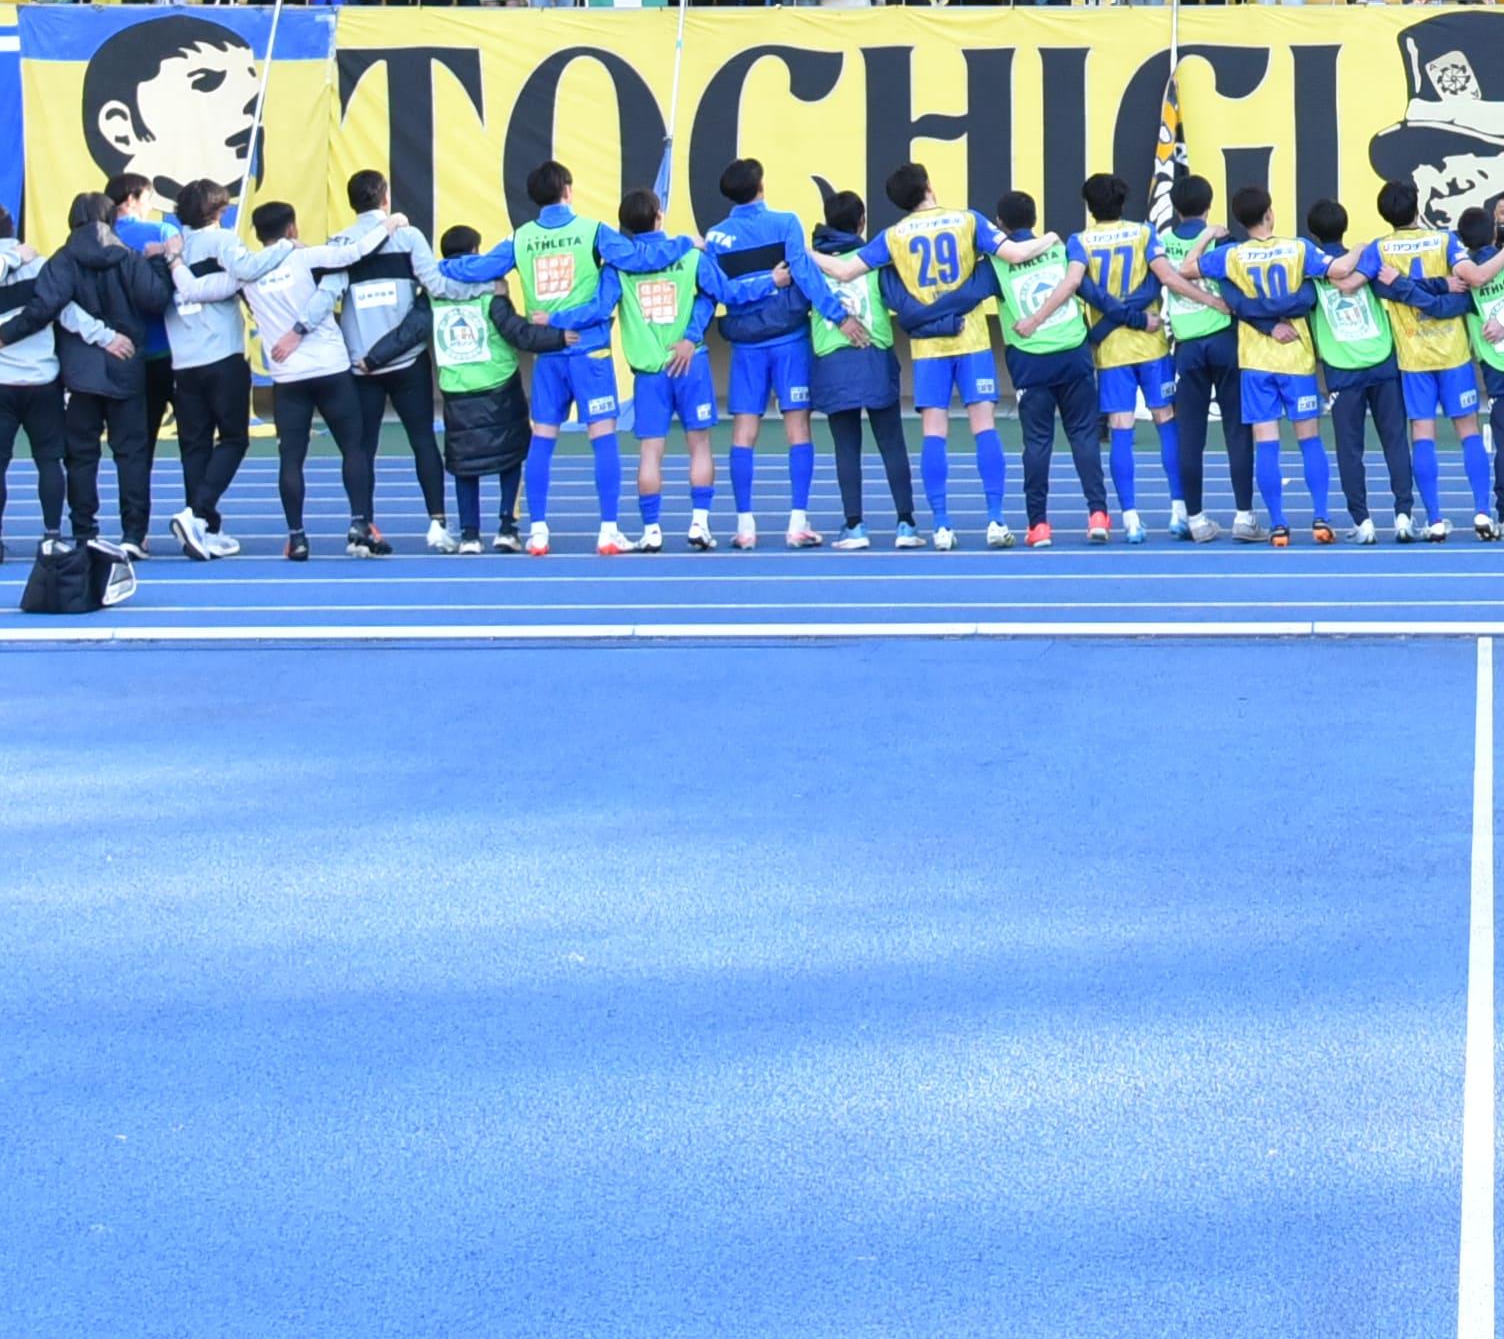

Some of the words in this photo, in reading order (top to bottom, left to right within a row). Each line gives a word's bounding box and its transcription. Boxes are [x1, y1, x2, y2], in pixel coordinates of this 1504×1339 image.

[336, 44, 1343, 244] TOCHIGI
[526, 237, 583, 253] ATHLETA
[908, 231, 963, 288] 29
[1007, 250, 1060, 273] ATHLETA
[1090, 245, 1136, 299] 77
